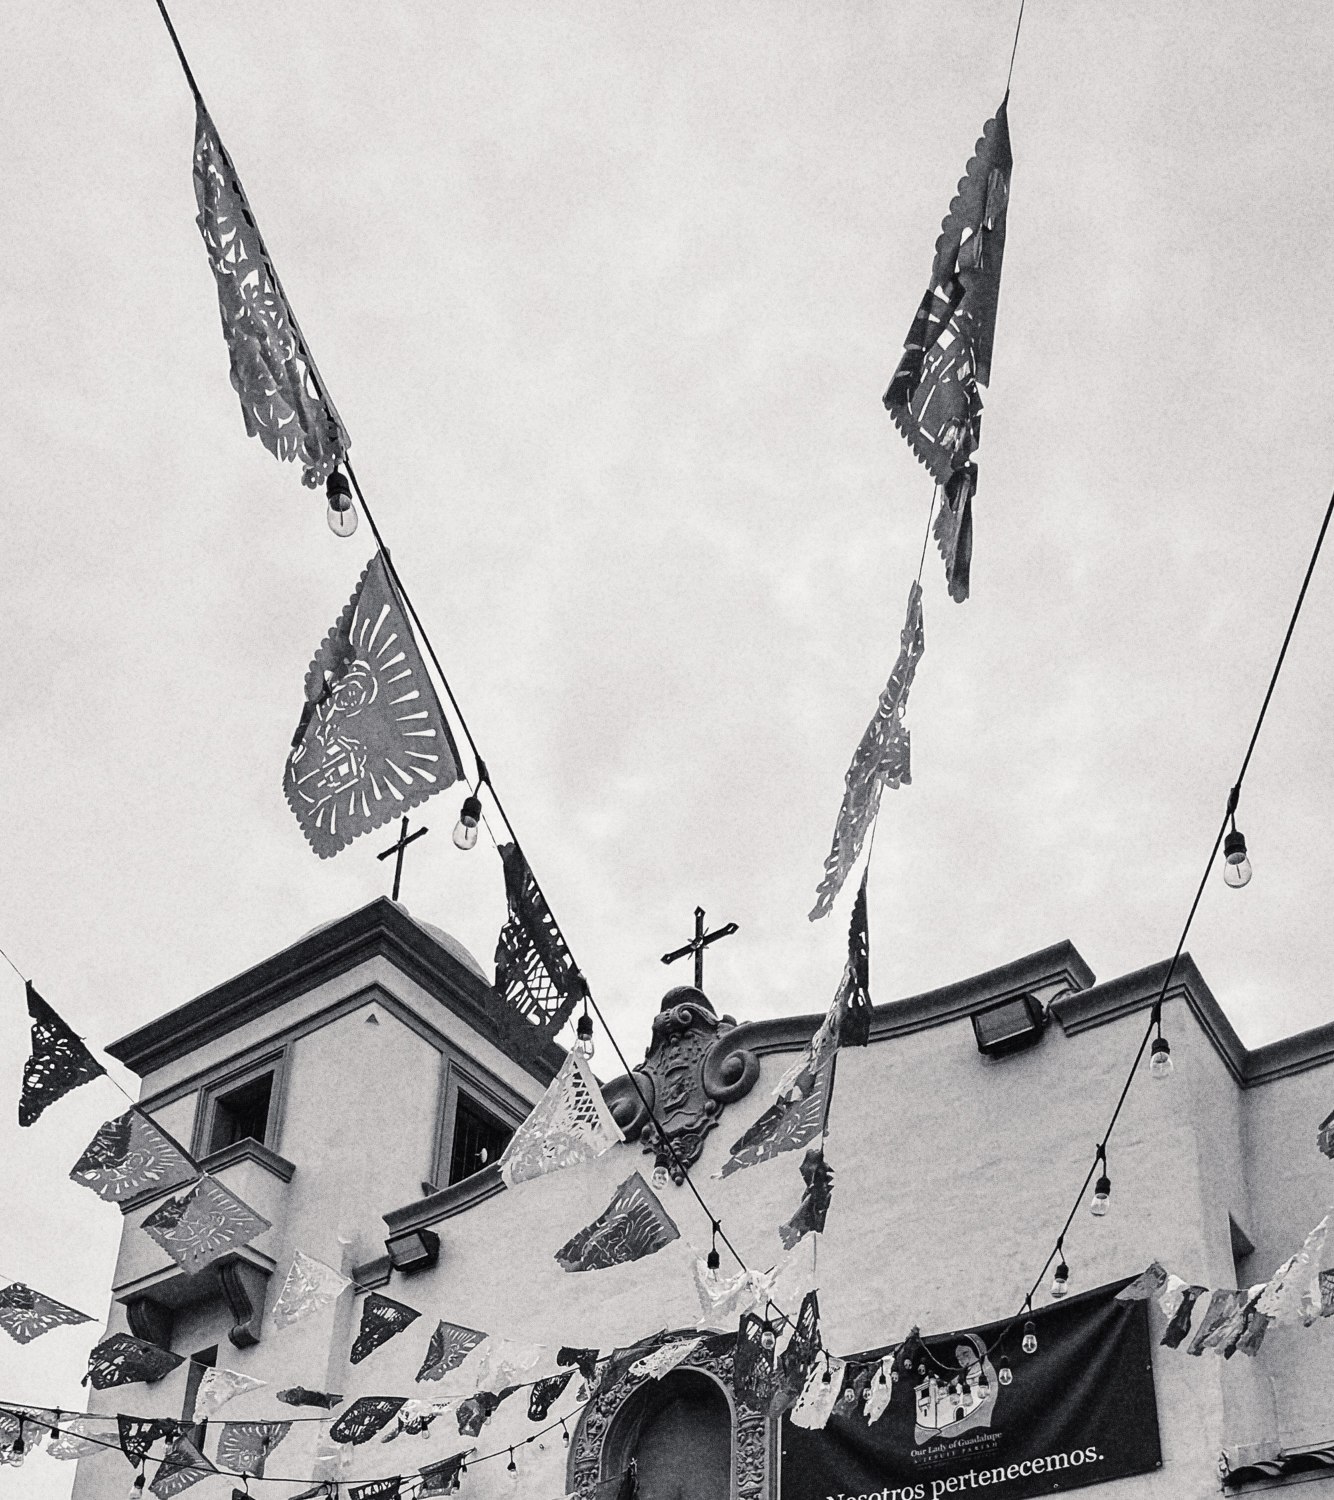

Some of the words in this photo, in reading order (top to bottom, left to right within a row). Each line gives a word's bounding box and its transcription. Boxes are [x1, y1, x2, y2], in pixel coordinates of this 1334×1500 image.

[928, 1443, 946, 1454] Lady
[948, 1440, 957, 1449] of
[957, 1432, 1003, 1447] Guadalupe
[931, 1446, 1105, 1500] pertenecemos.
